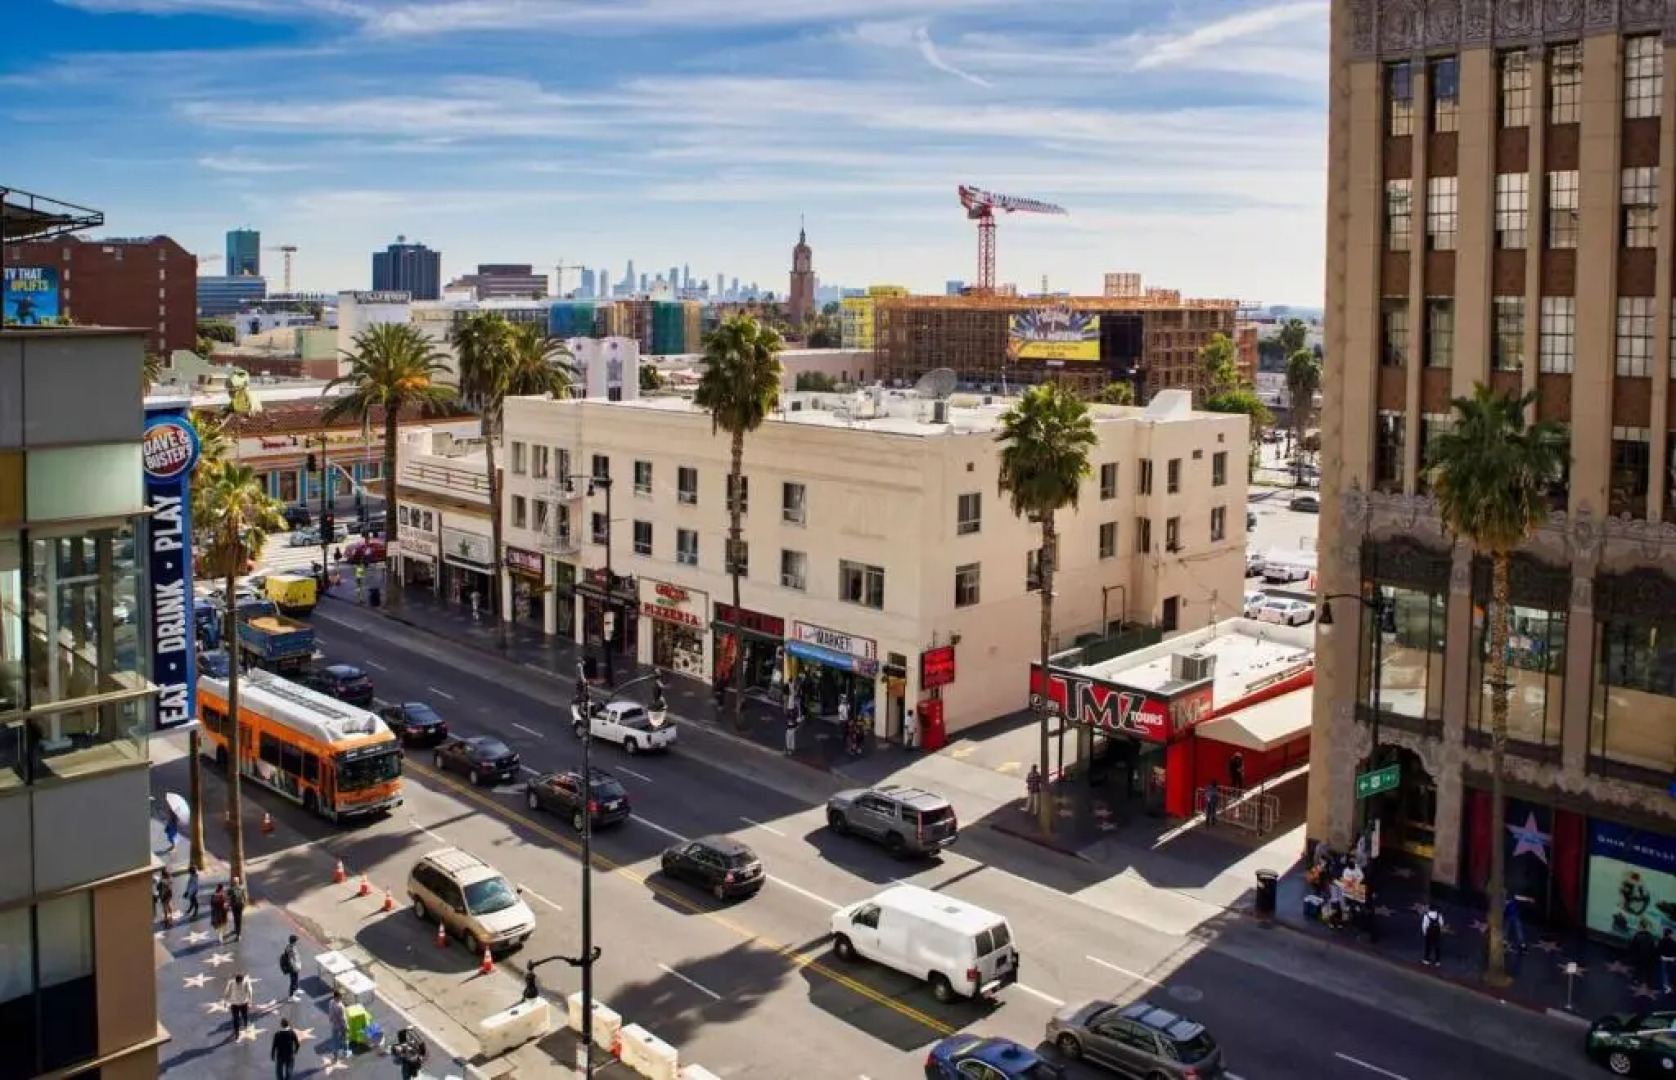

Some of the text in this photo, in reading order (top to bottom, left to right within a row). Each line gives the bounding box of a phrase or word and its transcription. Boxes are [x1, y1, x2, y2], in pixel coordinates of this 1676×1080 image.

[144, 431, 179, 456] DAVE
[153, 495, 189, 726] EAT DRINK PLAY
[643, 602, 700, 626] PIZZERIA
[817, 627, 852, 650] MARKET
[1051, 673, 1163, 734] TMZ TOURS
